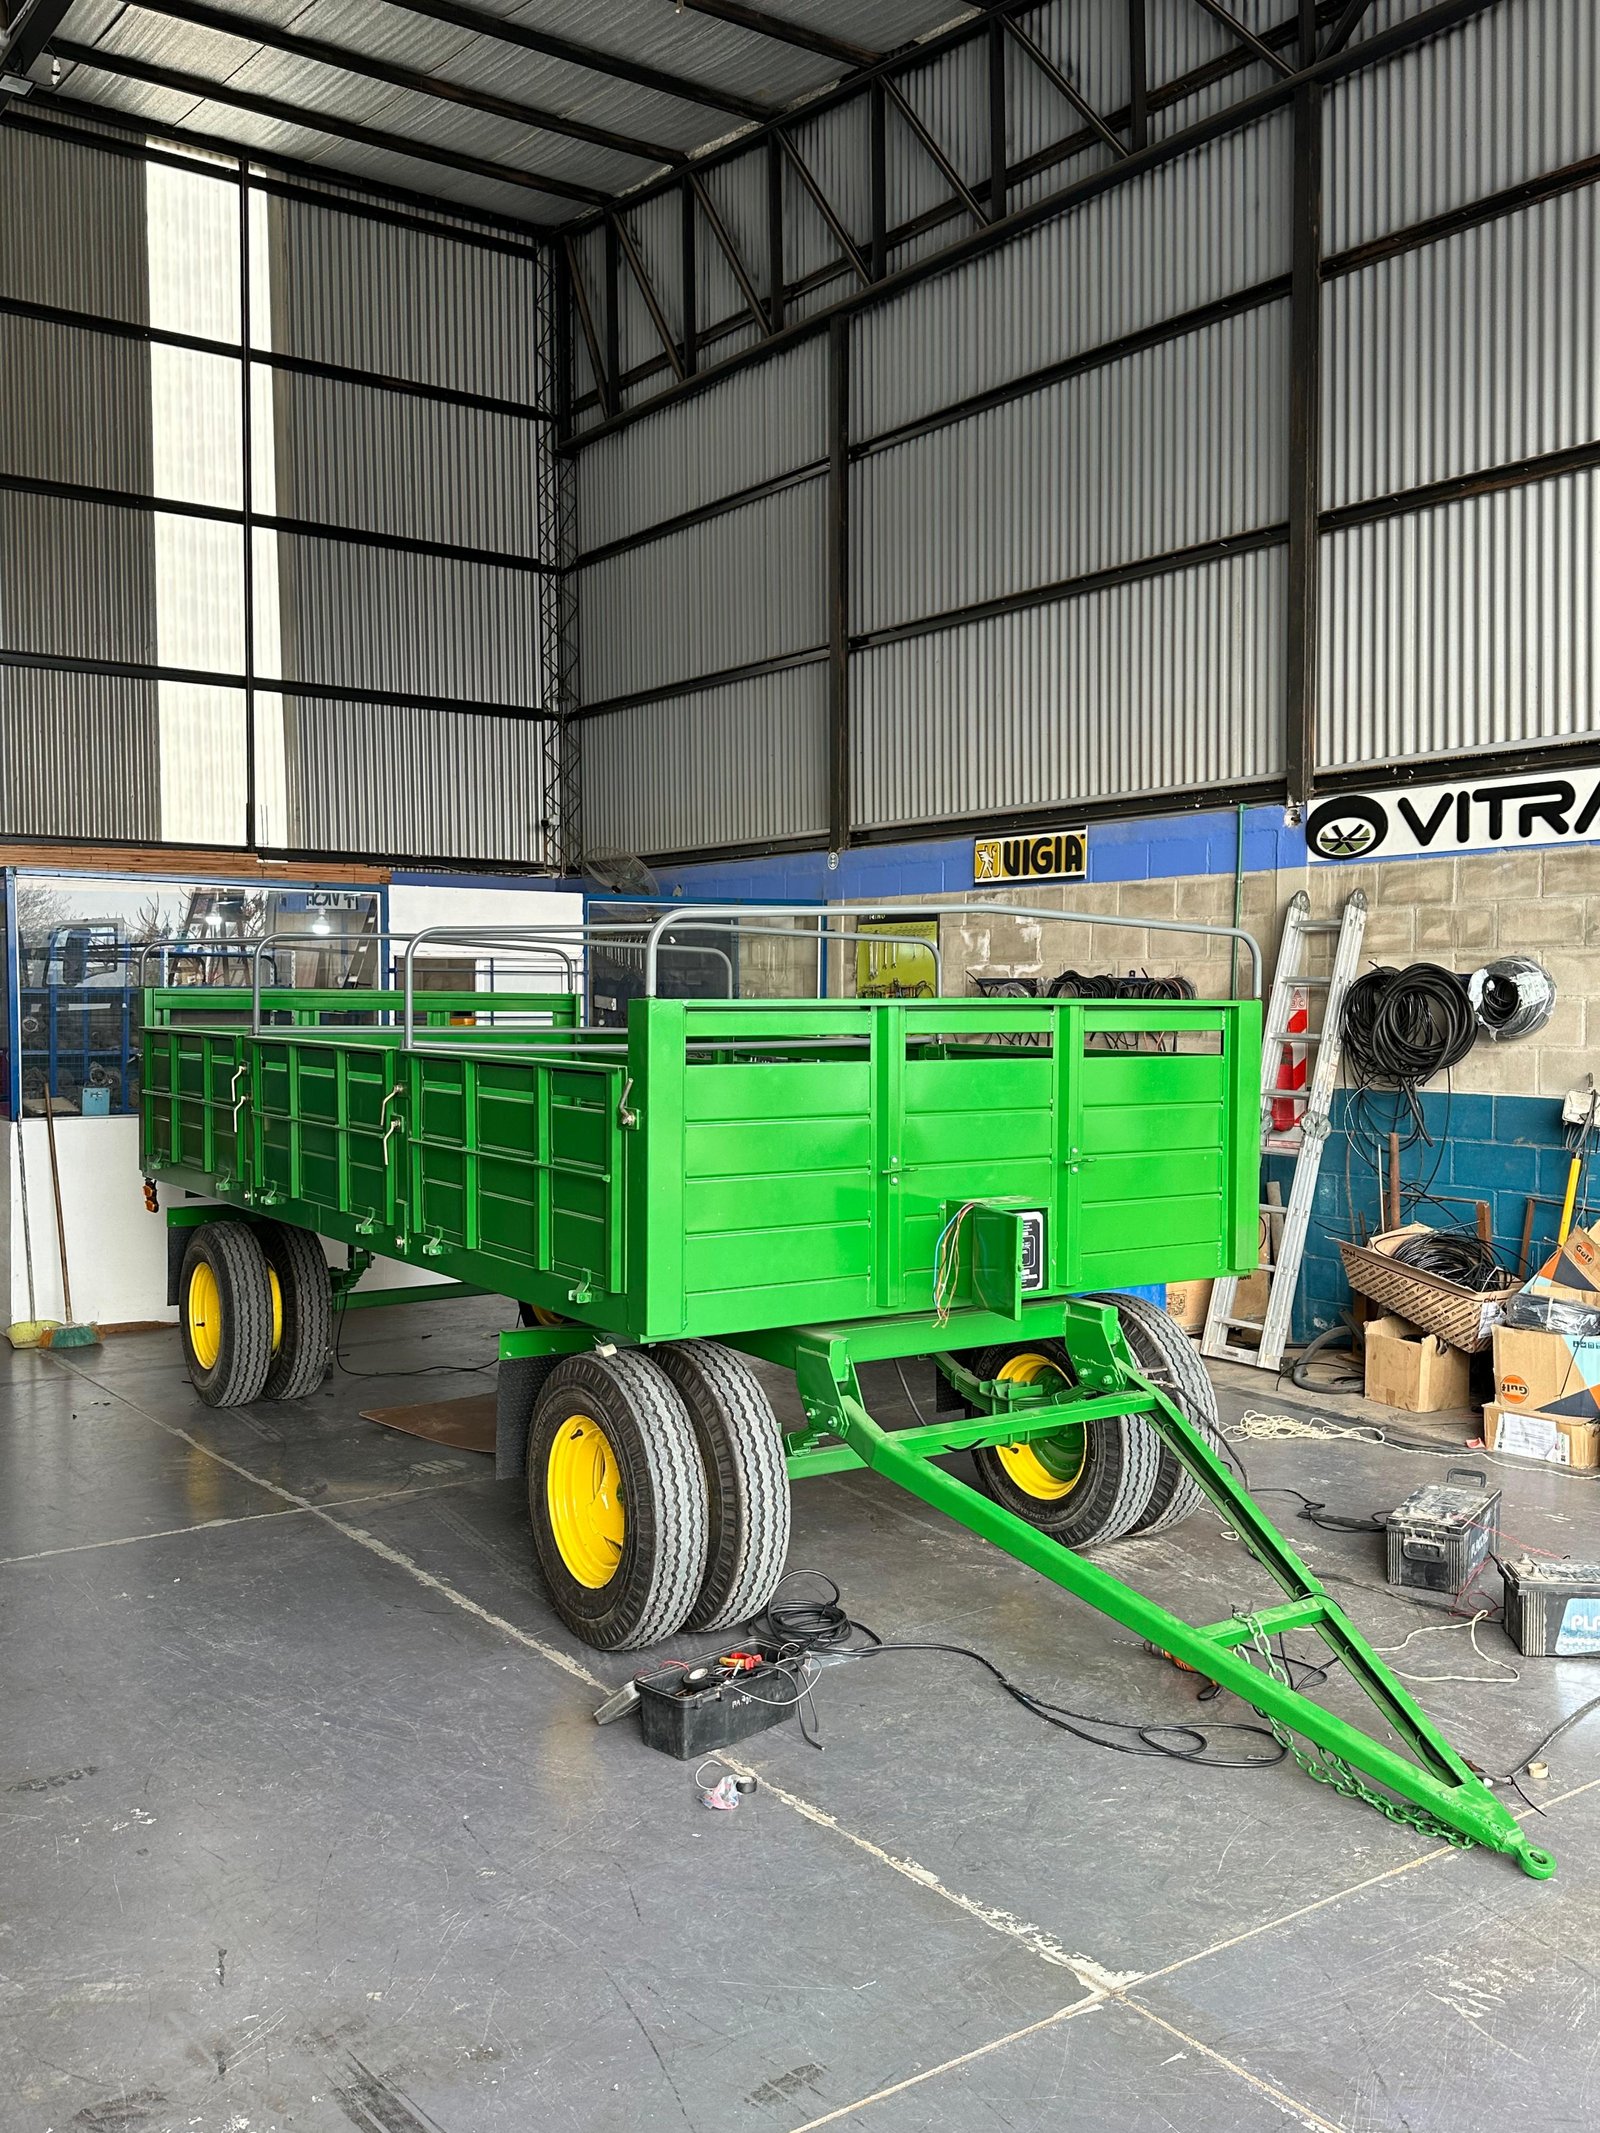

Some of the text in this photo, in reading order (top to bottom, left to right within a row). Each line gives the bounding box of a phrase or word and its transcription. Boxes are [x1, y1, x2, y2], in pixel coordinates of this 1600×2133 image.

[1003, 834, 1083, 877] VIGIA
[1576, 1244, 1593, 1263] Gulf
[1501, 1383, 1528, 1395] Gulf
